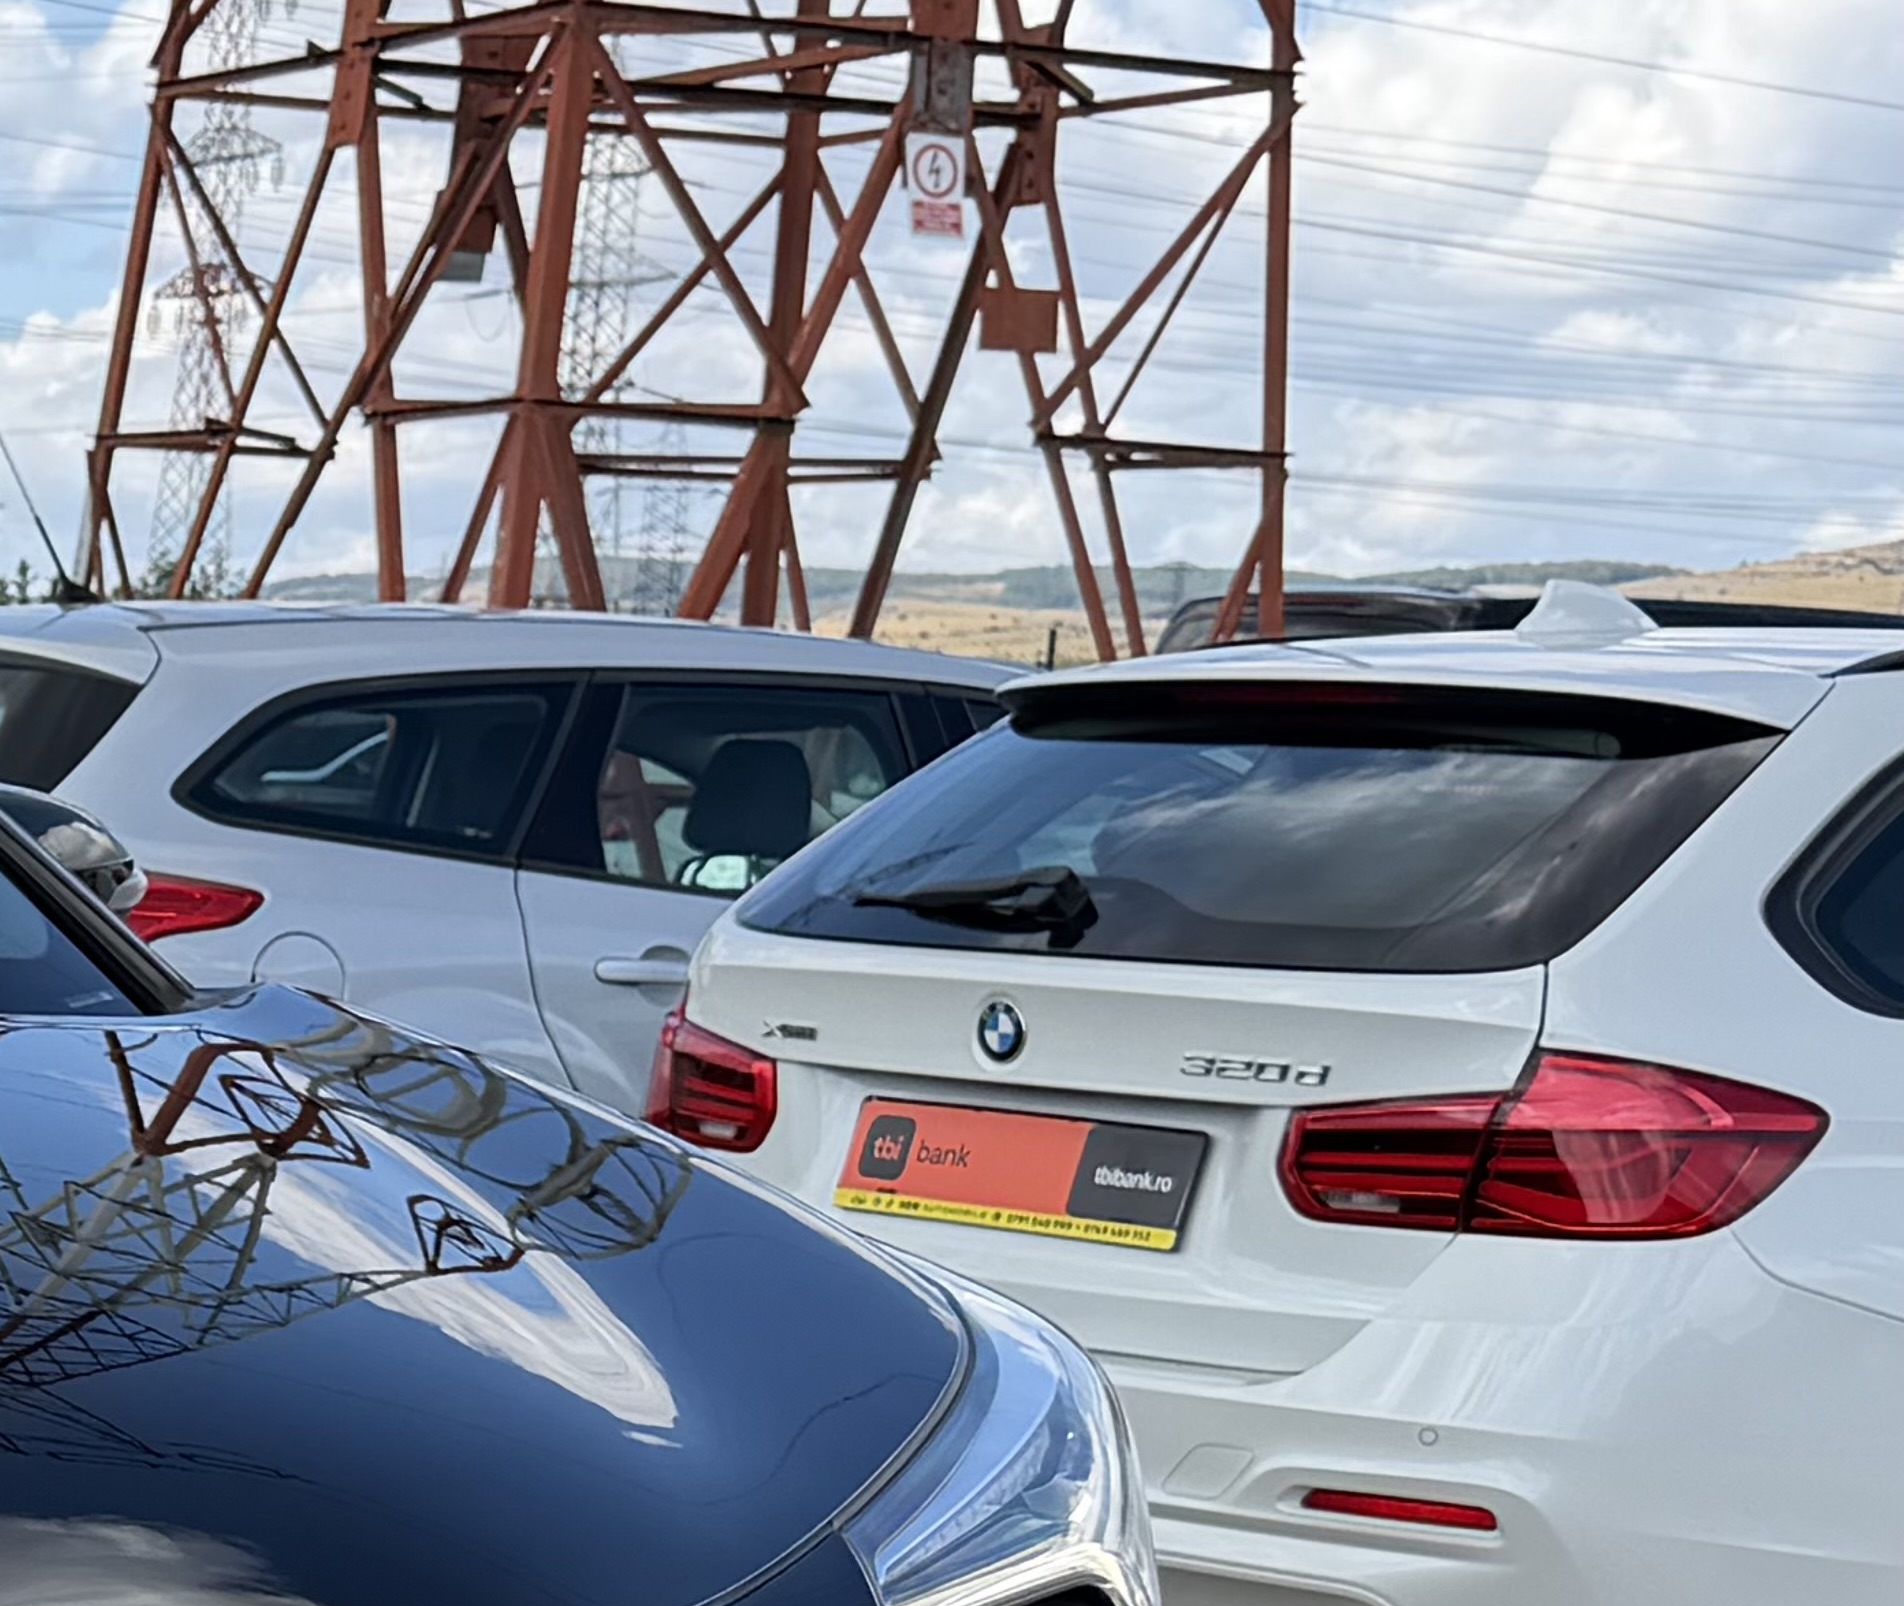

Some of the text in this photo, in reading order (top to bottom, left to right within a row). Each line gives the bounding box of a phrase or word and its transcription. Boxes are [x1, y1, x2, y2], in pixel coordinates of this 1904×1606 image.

[873, 1135, 970, 1168] tbi bank
[1094, 1165, 1172, 1193] tbibank.ro
